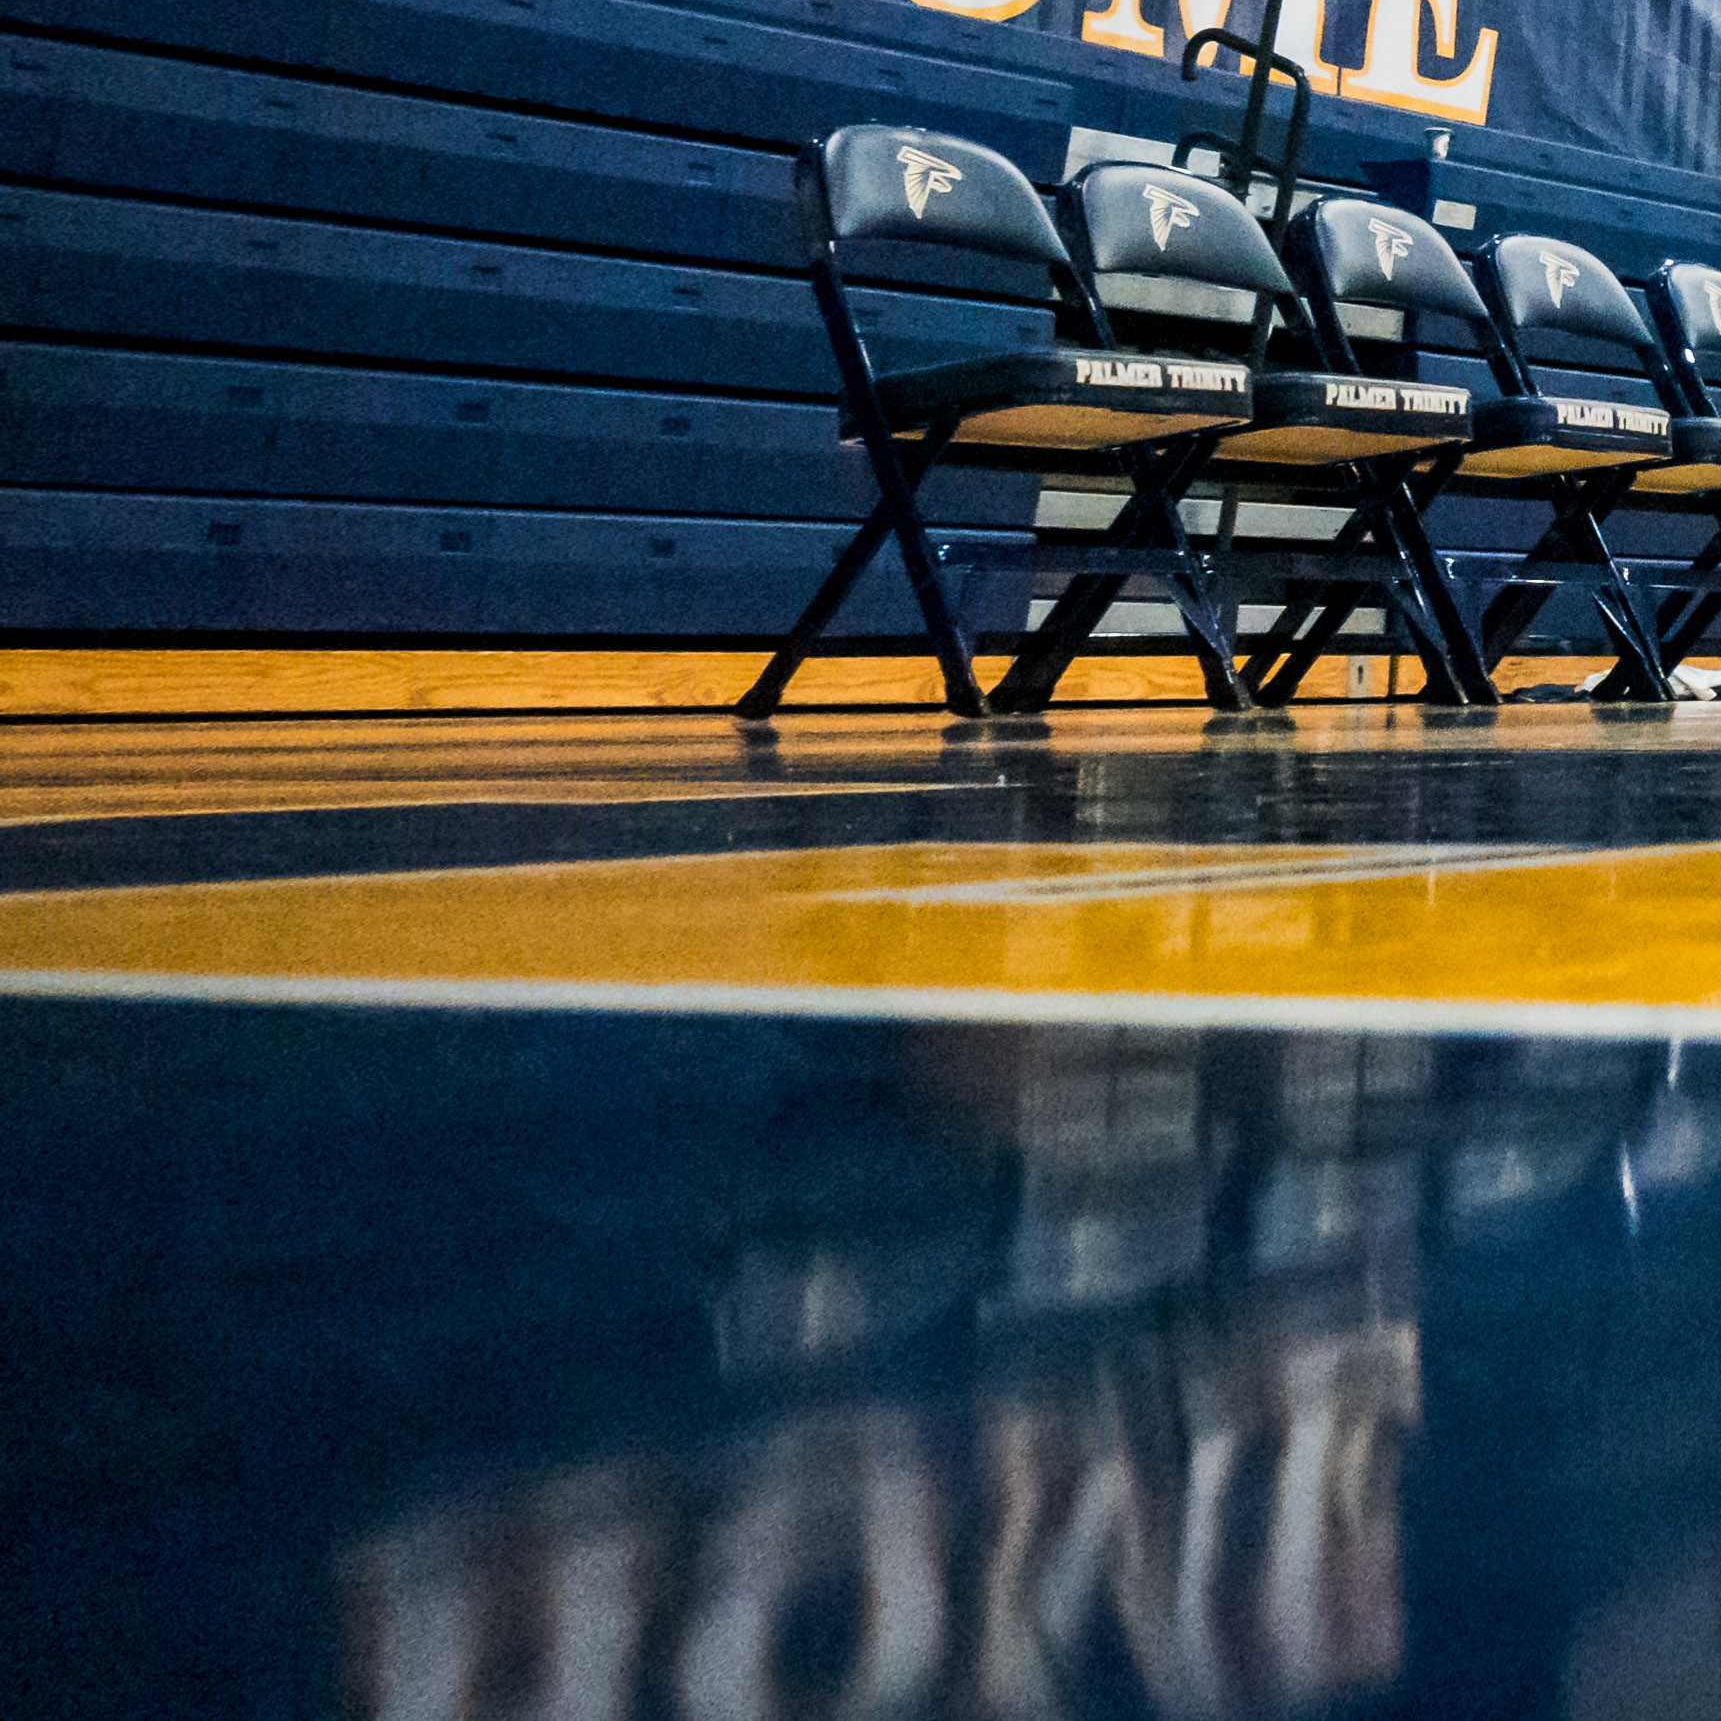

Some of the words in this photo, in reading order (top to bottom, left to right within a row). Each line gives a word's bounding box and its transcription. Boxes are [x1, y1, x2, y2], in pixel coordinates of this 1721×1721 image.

[1076, 358, 1164, 388] PALMER
[1167, 364, 1247, 393] TRINITY
[1325, 383, 1397, 410] PALMER
[1400, 389, 1469, 415] TRINITY
